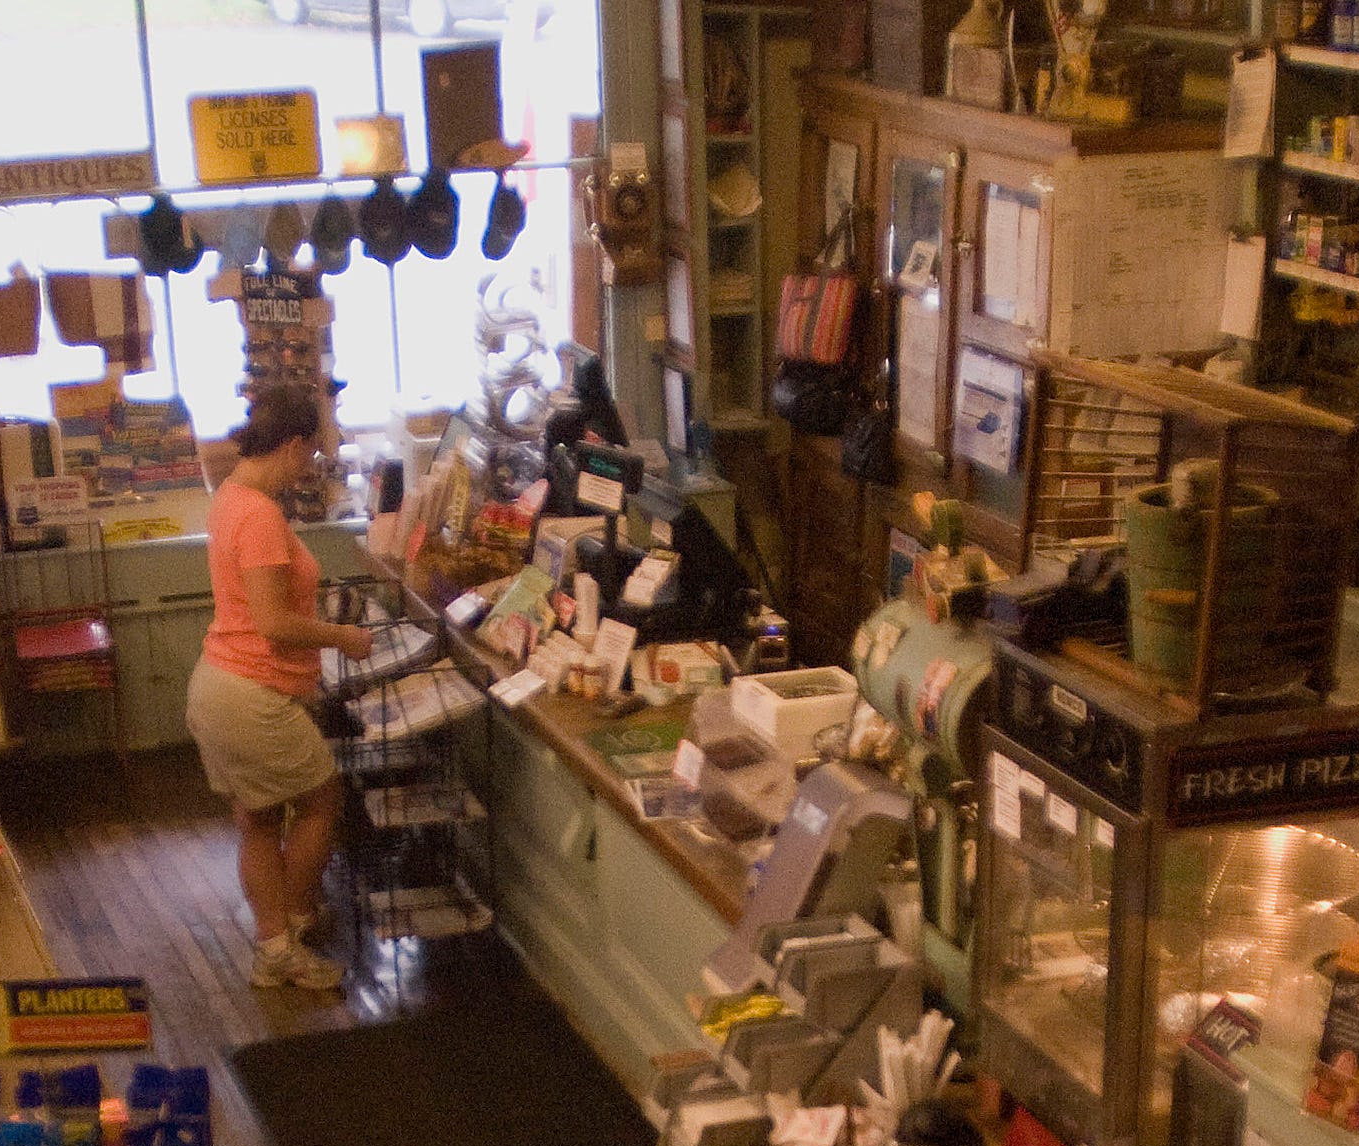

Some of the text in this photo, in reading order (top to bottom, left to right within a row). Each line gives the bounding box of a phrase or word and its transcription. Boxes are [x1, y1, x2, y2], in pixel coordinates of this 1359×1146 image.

[219, 110, 288, 128] LICENSES
[216, 128, 298, 149] SOLD HERE
[1182, 762, 1285, 799] FRESH
[16, 985, 128, 1014] PLANTERS
[1205, 1014, 1250, 1050] HOT
